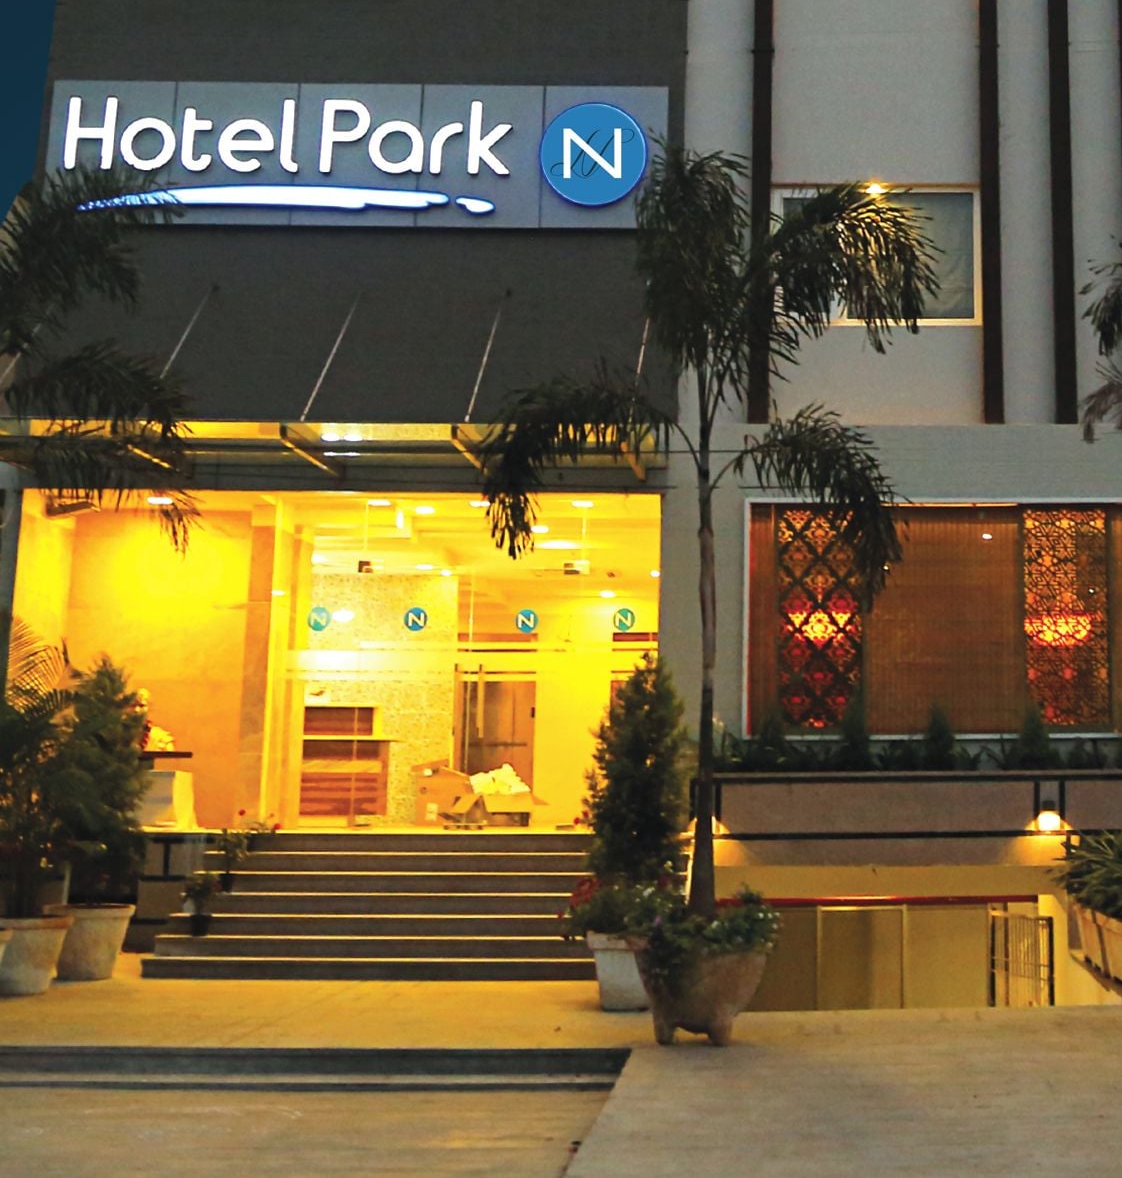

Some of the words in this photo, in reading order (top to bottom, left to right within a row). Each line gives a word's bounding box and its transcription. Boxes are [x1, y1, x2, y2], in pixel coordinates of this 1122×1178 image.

[63, 96, 298, 174] Hotel
[318, 98, 513, 176] Park
[562, 127, 622, 179] N
[407, 612, 425, 627] N
[517, 613, 535, 628] N
[614, 611, 632, 626] N
